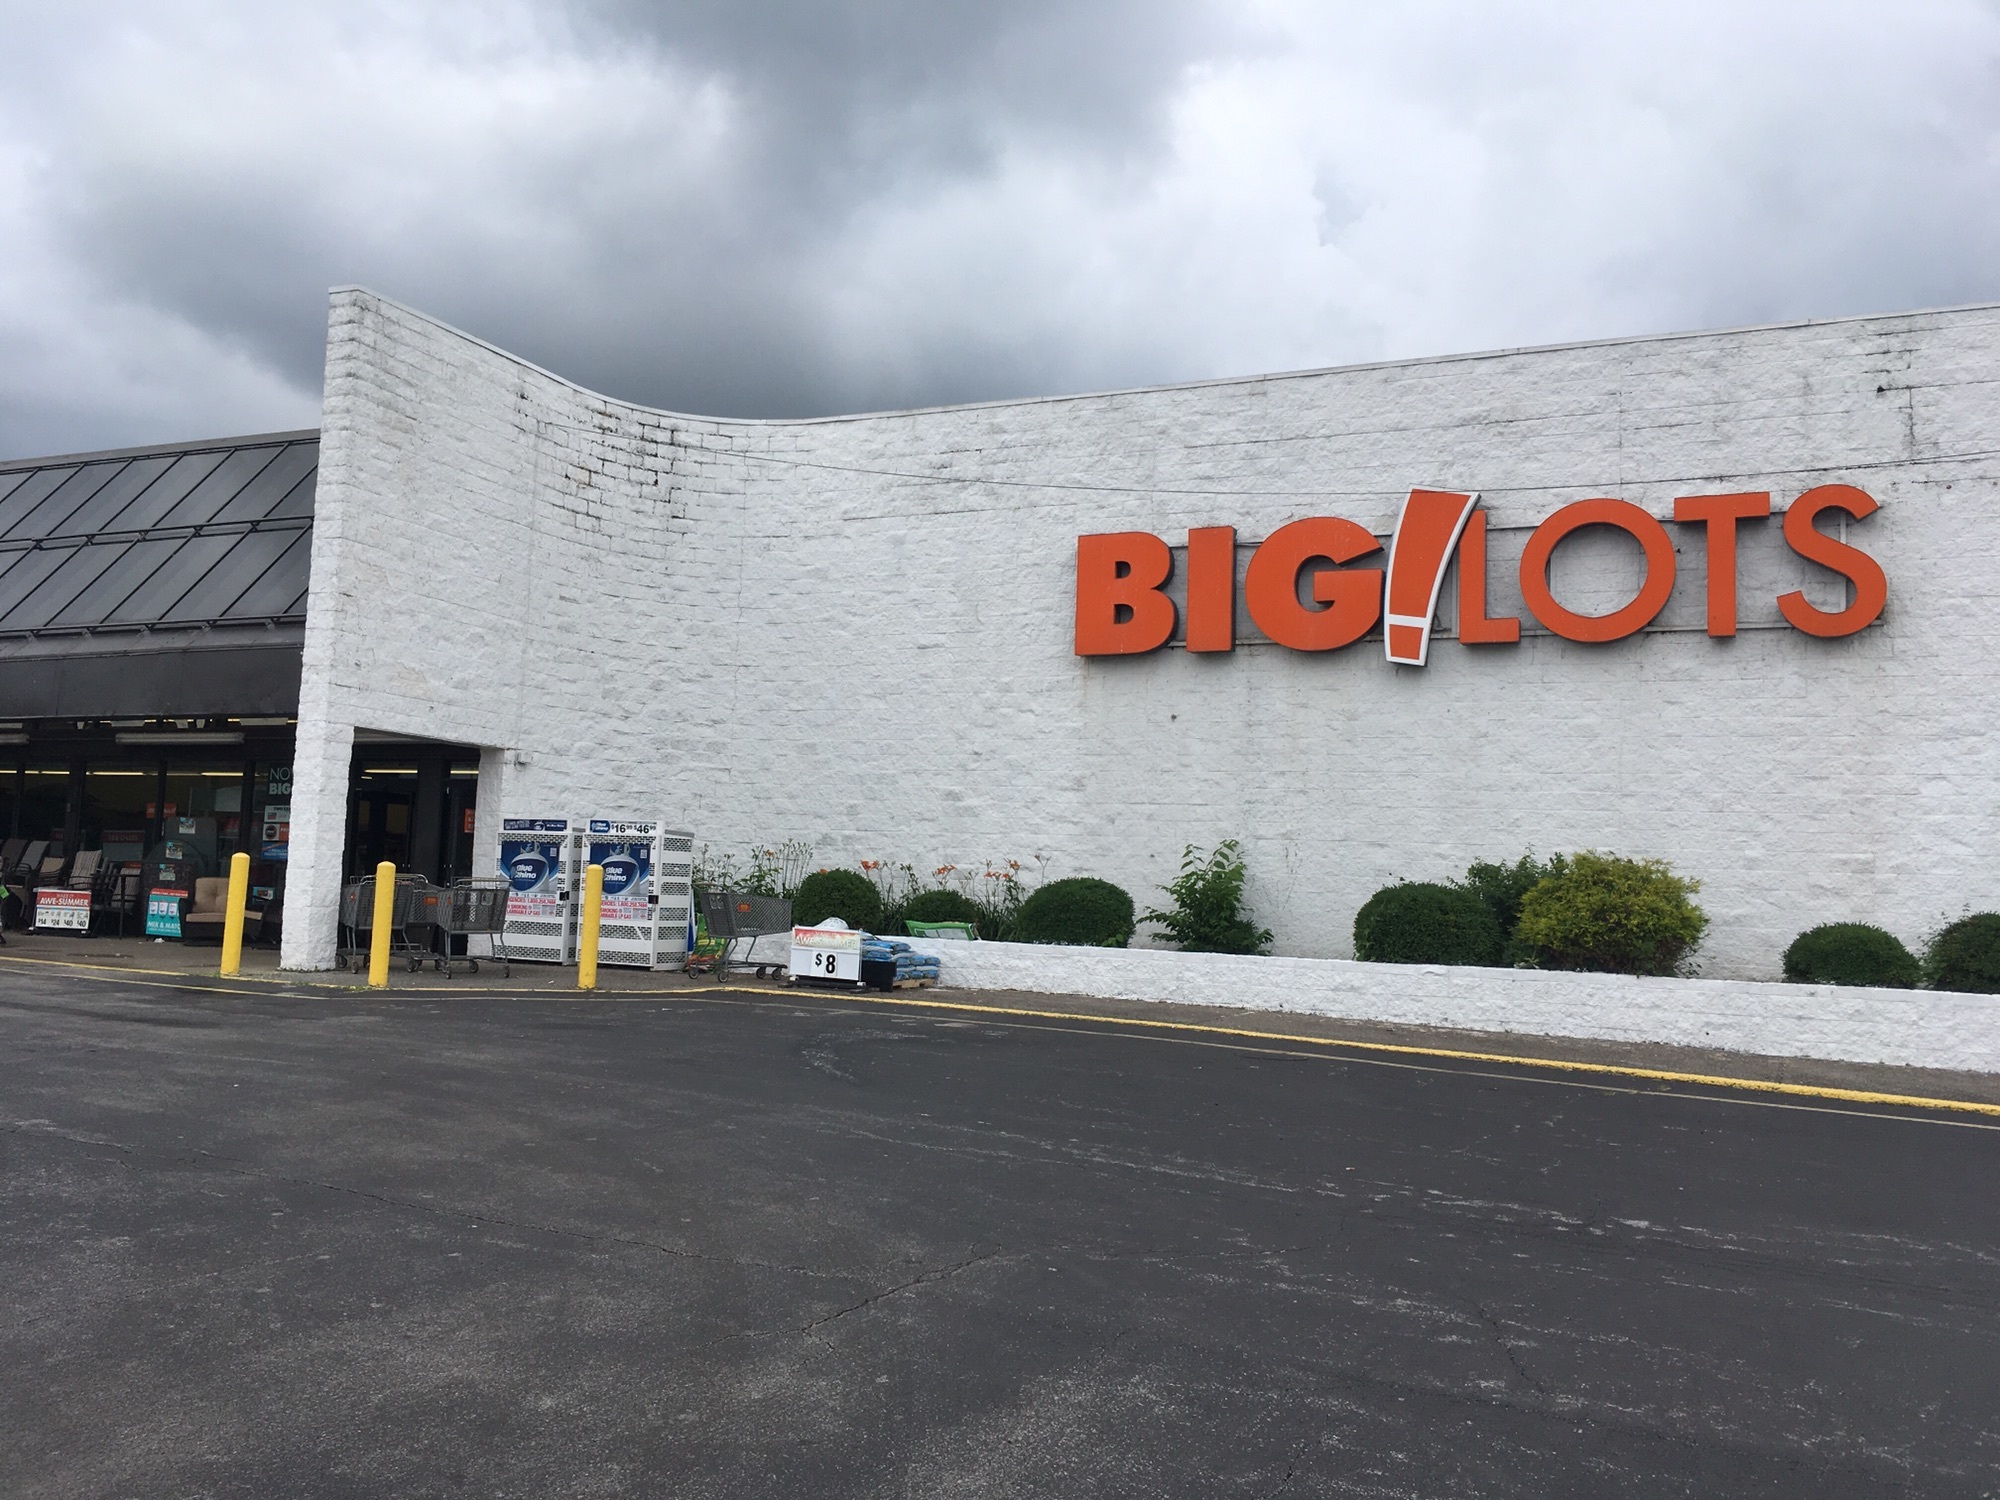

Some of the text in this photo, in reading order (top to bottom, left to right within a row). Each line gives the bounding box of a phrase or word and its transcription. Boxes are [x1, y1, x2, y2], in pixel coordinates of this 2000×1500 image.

[1459, 484, 1887, 647] LOTS
[270, 767, 291, 780] NO
[40, 897, 89, 906] AWE-SUMMER
[165, 922, 181, 930] MATC
